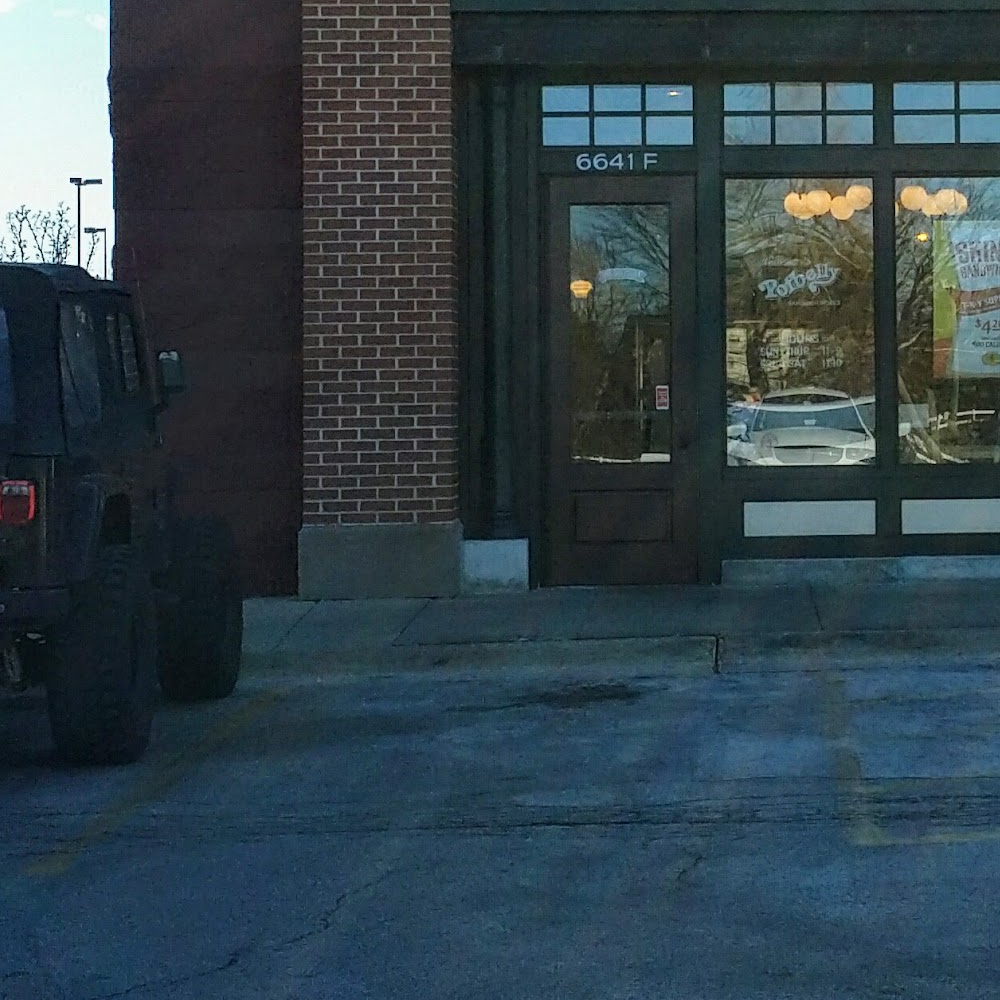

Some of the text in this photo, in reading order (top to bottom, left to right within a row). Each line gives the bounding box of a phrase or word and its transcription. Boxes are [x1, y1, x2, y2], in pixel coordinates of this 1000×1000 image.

[576, 153, 658, 171] 6641 F
[758, 263, 841, 301] Potbelly
